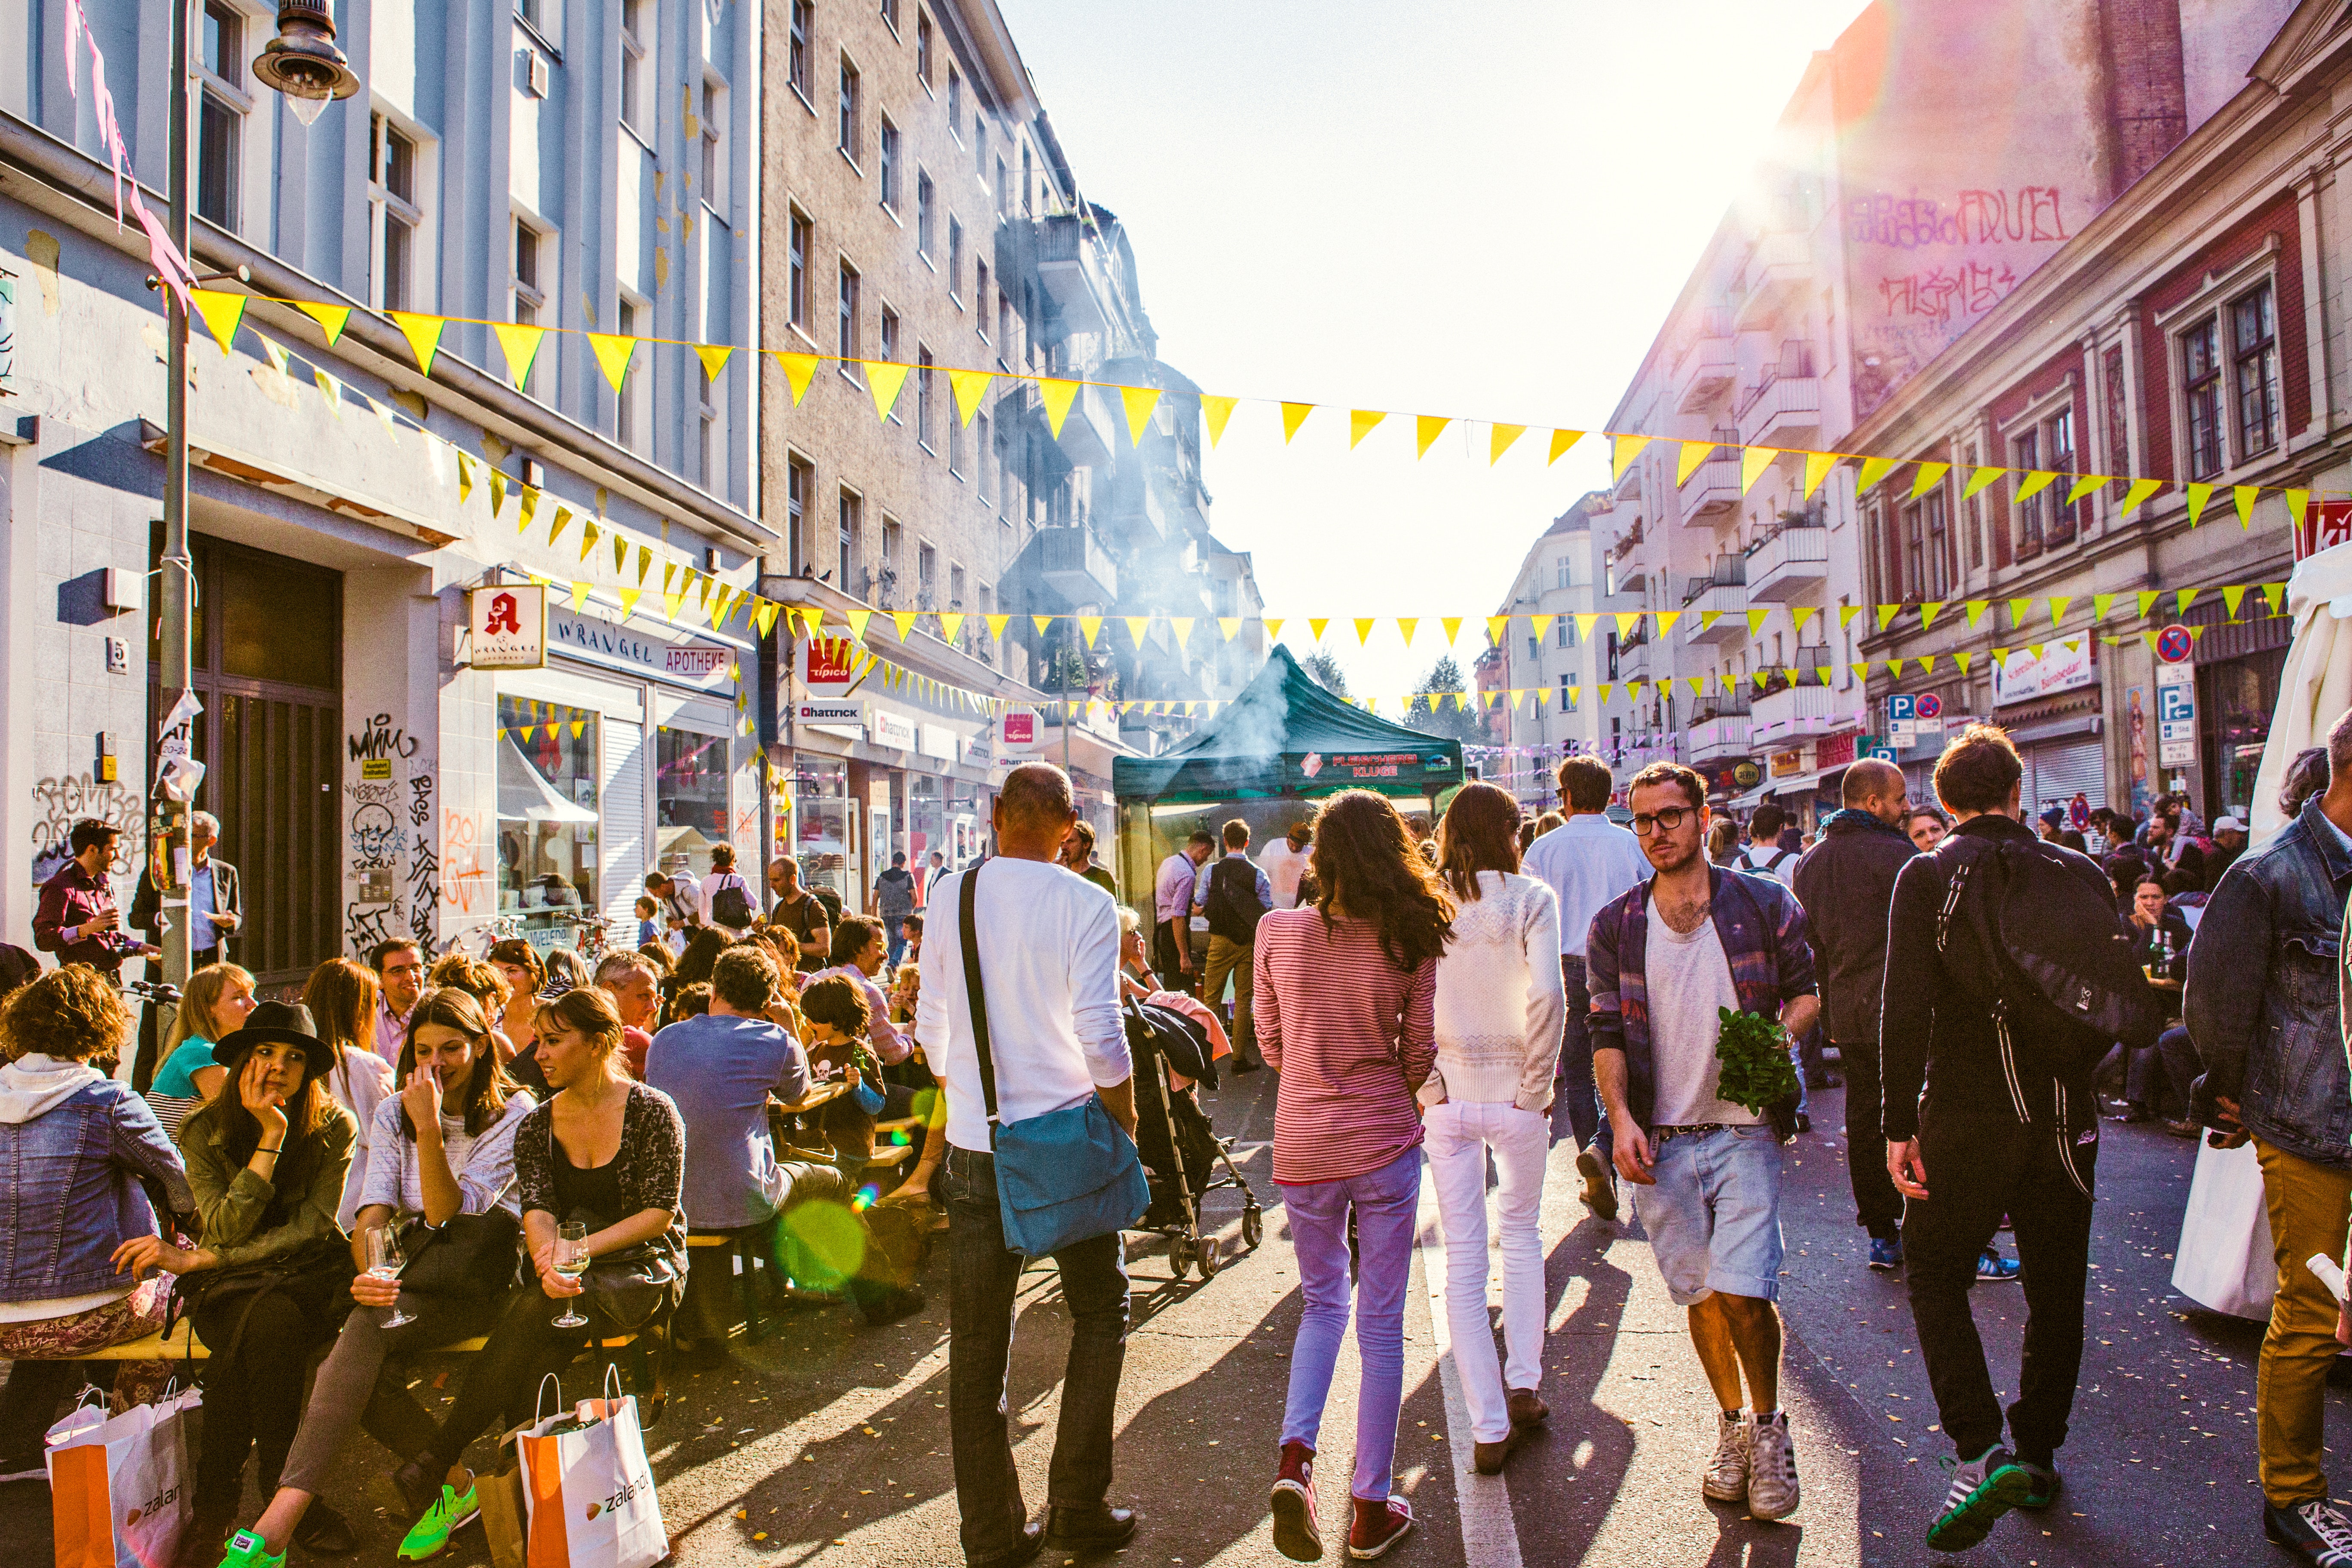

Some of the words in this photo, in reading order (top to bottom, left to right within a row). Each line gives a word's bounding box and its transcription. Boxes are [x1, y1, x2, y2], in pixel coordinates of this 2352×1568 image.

[559, 620, 652, 662] WRANGEL
[115, 642, 124, 660] 5
[666, 651, 724, 671] APOTHEKE
[810, 663, 848, 678] tipico
[811, 707, 858, 717] hattrick
[1895, 698, 1909, 717] P
[2164, 690, 2180, 720] P
[1006, 729, 1032, 740] tipico
[1333, 753, 1417, 766] FLEISCHEREI
[1353, 766, 1398, 777] KLUGE
